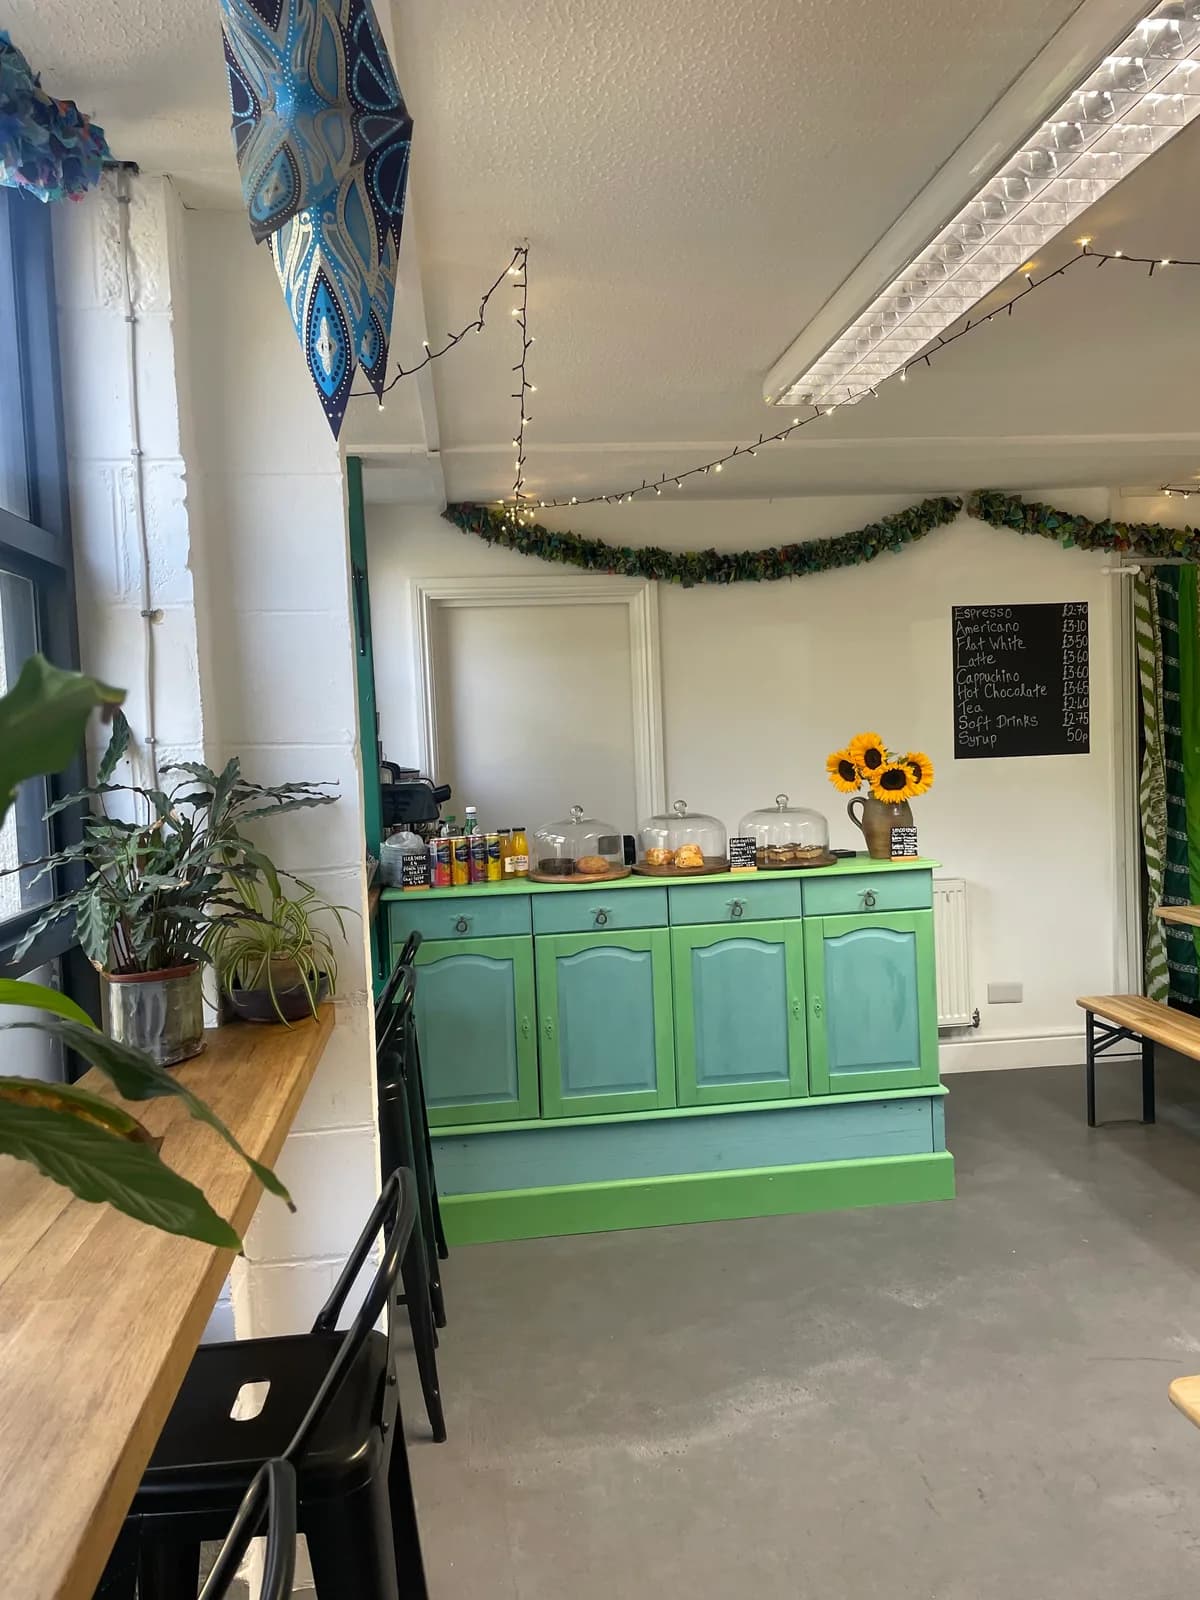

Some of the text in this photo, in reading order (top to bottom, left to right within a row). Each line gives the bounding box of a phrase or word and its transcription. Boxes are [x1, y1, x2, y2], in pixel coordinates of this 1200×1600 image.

[954, 607, 1013, 621] Espresso
[955, 620, 1020, 637] Americano
[956, 635, 1027, 652] Flat White
[956, 651, 996, 669] Latte
[956, 668, 1020, 686] Cappuchino
[957, 683, 1048, 700] Hot Chocolate
[958, 699, 984, 716] Tea
[958, 714, 1039, 732] Soft Drinks
[958, 731, 997, 749] Syrup
[1067, 727, 1088, 743] 50p
